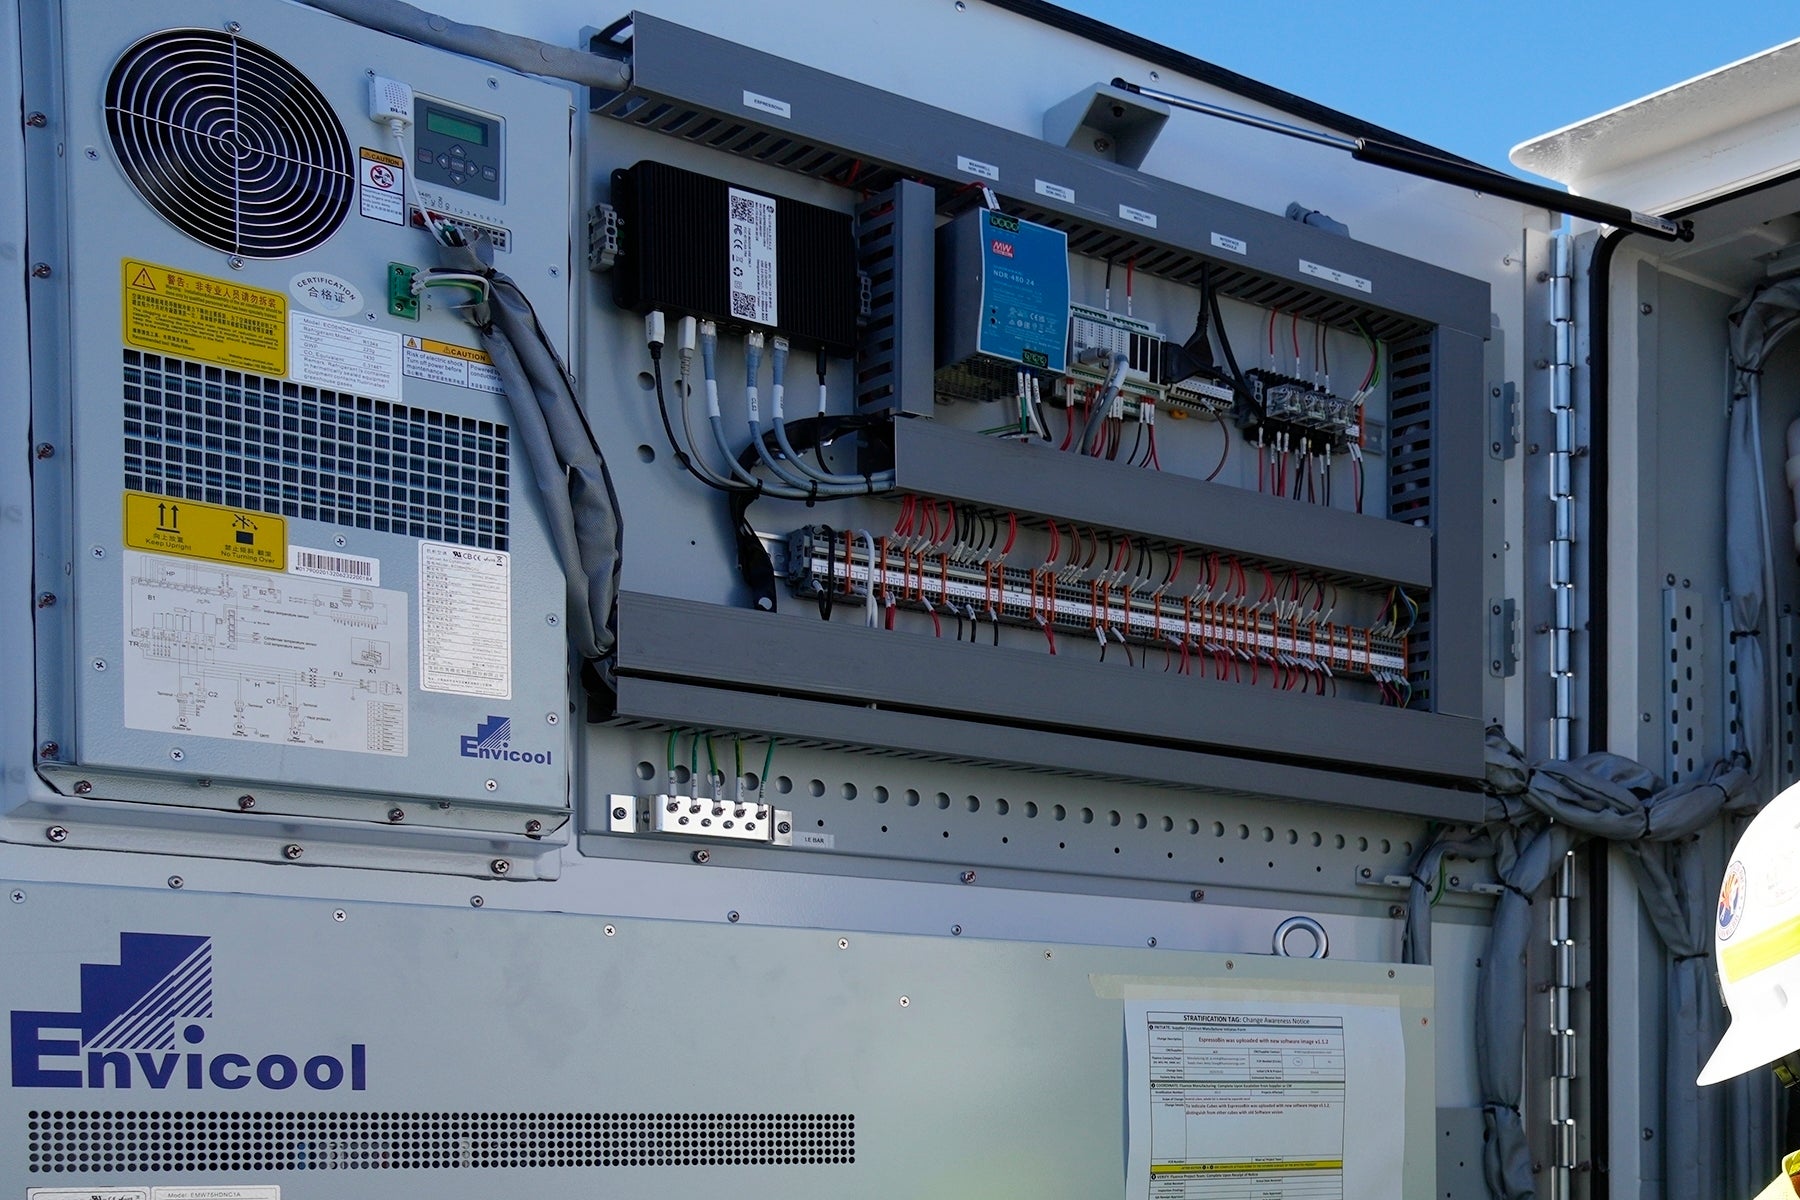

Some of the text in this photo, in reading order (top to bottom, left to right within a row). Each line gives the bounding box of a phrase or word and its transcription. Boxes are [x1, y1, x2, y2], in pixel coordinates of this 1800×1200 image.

[371, 154, 400, 166] CAUTION
[297, 277, 356, 301] CERTIFICATION
[308, 286, 345, 303] 合格证
[426, 355, 446, 363] electric
[451, 349, 486, 360] CAUTION
[428, 362, 443, 370] power
[445, 364, 461, 373] before
[470, 364, 493, 374] Powered
[146, 539, 192, 551] Keep Upright
[233, 552, 257, 562] Turning
[461, 735, 551, 765] Envicool
[1183, 1015, 1227, 1023] STRATIFICATION
[1242, 1017, 1263, 1025] Change
[1199, 1036, 1225, 1044] EspressoBin
[11, 1010, 366, 1090] Envicool
